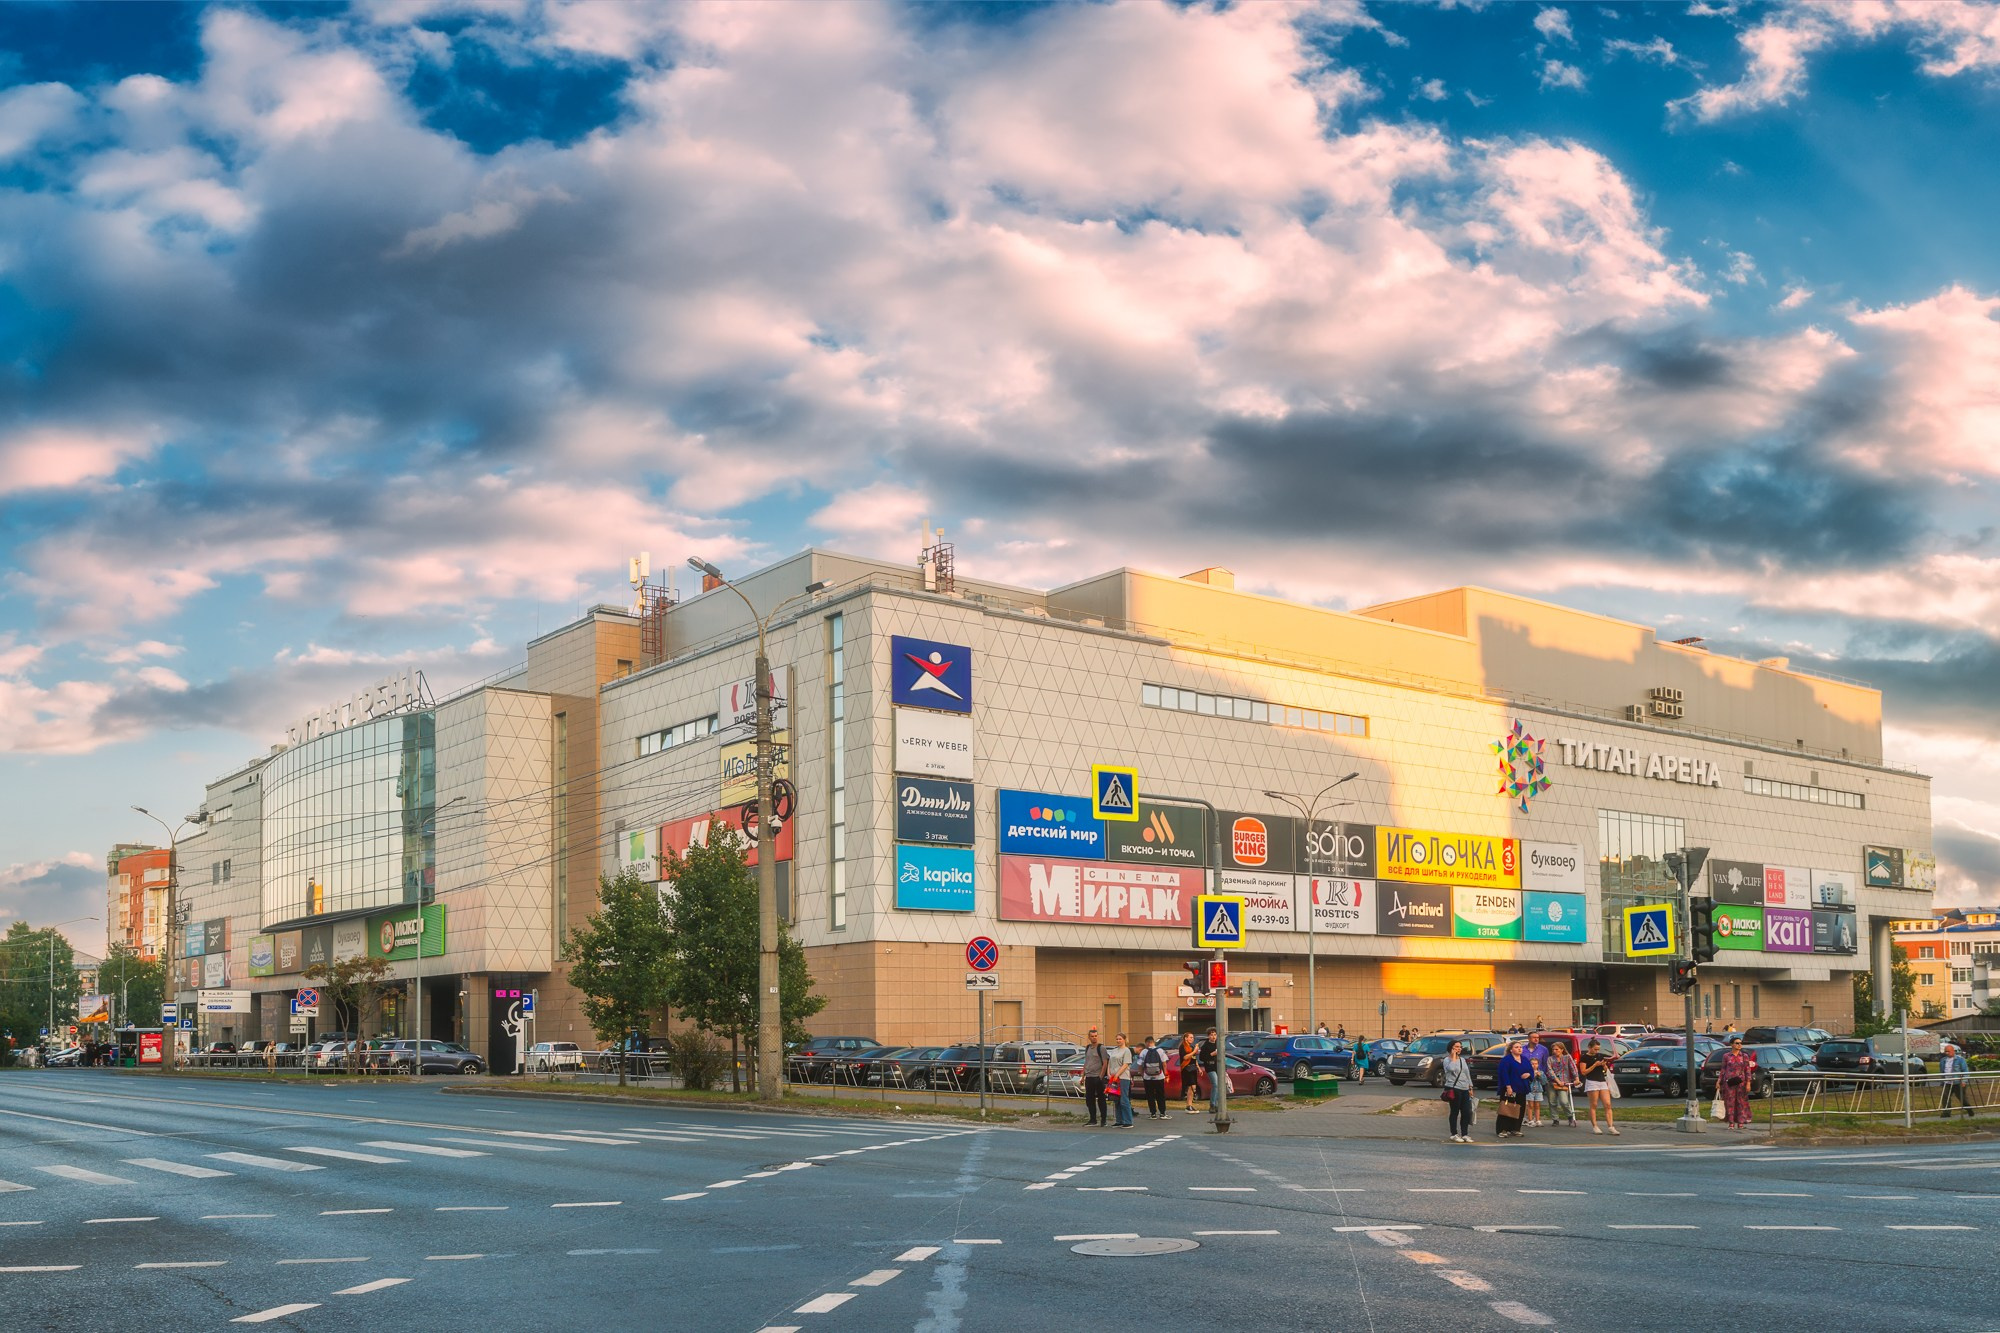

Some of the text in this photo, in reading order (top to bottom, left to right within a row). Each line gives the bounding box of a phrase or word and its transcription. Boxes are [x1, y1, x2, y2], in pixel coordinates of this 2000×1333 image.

[936, 741, 968, 752] WEBER
[1558, 738, 1723, 787] ТИТАН АРЕНА
[906, 809, 942, 817] джинсовая
[932, 833, 949, 841] этаж
[1008, 825, 1098, 844] детский мир
[1234, 831, 1266, 844] BURGER
[1121, 845, 1154, 855] ВКУСНО
[1162, 848, 1168, 856] И
[1169, 848, 1195, 858] ТОЧКА
[1234, 842, 1266, 857] KING
[1387, 832, 1496, 870] ИГОЛОЧКА
[1505, 852, 1512, 863] 3
[1531, 849, 1576, 872] буквоед
[923, 866, 972, 887] kapika
[1089, 870, 1175, 883] CINEMA
[1388, 866, 1497, 881] ВСЁ ДЛЯ ШИТЬЯ И РУКОДЕЛИЯ
[1713, 873, 1761, 887] VAN CLIFF
[1221, 877, 1286, 887] одземный паркинг
[1244, 896, 1289, 910] ОМОЙКА
[1408, 901, 1444, 917] indiwd
[1475, 895, 1516, 909] ZENDEN
[1251, 914, 1290, 925] 49-39-03
[1314, 908, 1360, 919] ROSTIC'S
[1481, 928, 1500, 936] ЭТАЖ
[1767, 915, 1810, 946] kari
